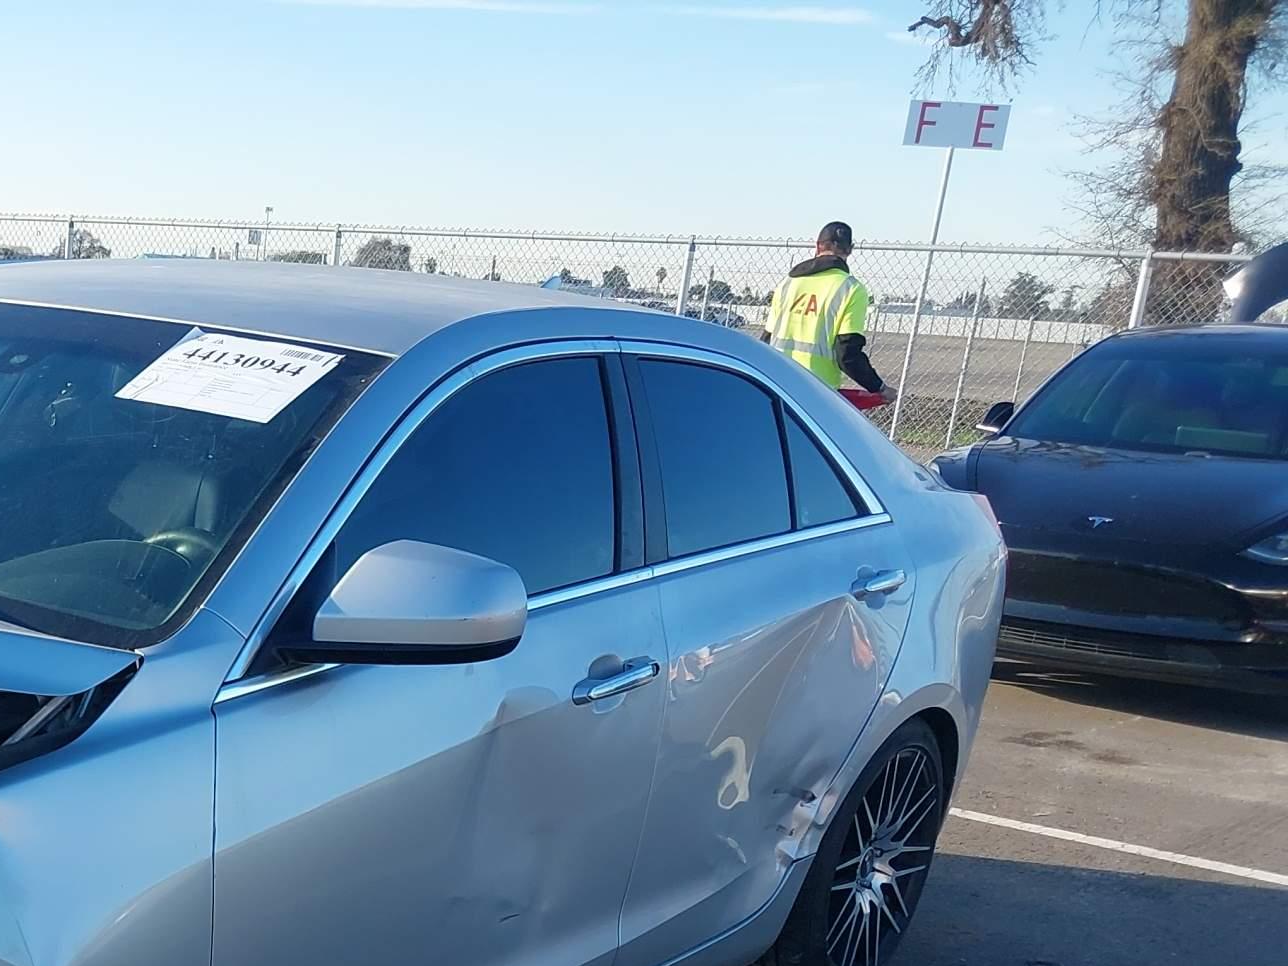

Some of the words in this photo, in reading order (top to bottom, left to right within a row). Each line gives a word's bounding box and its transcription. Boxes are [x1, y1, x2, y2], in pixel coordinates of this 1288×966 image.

[914, 101, 942, 145] F
[971, 105, 1000, 148] E
[182, 347, 307, 377] 44130944
